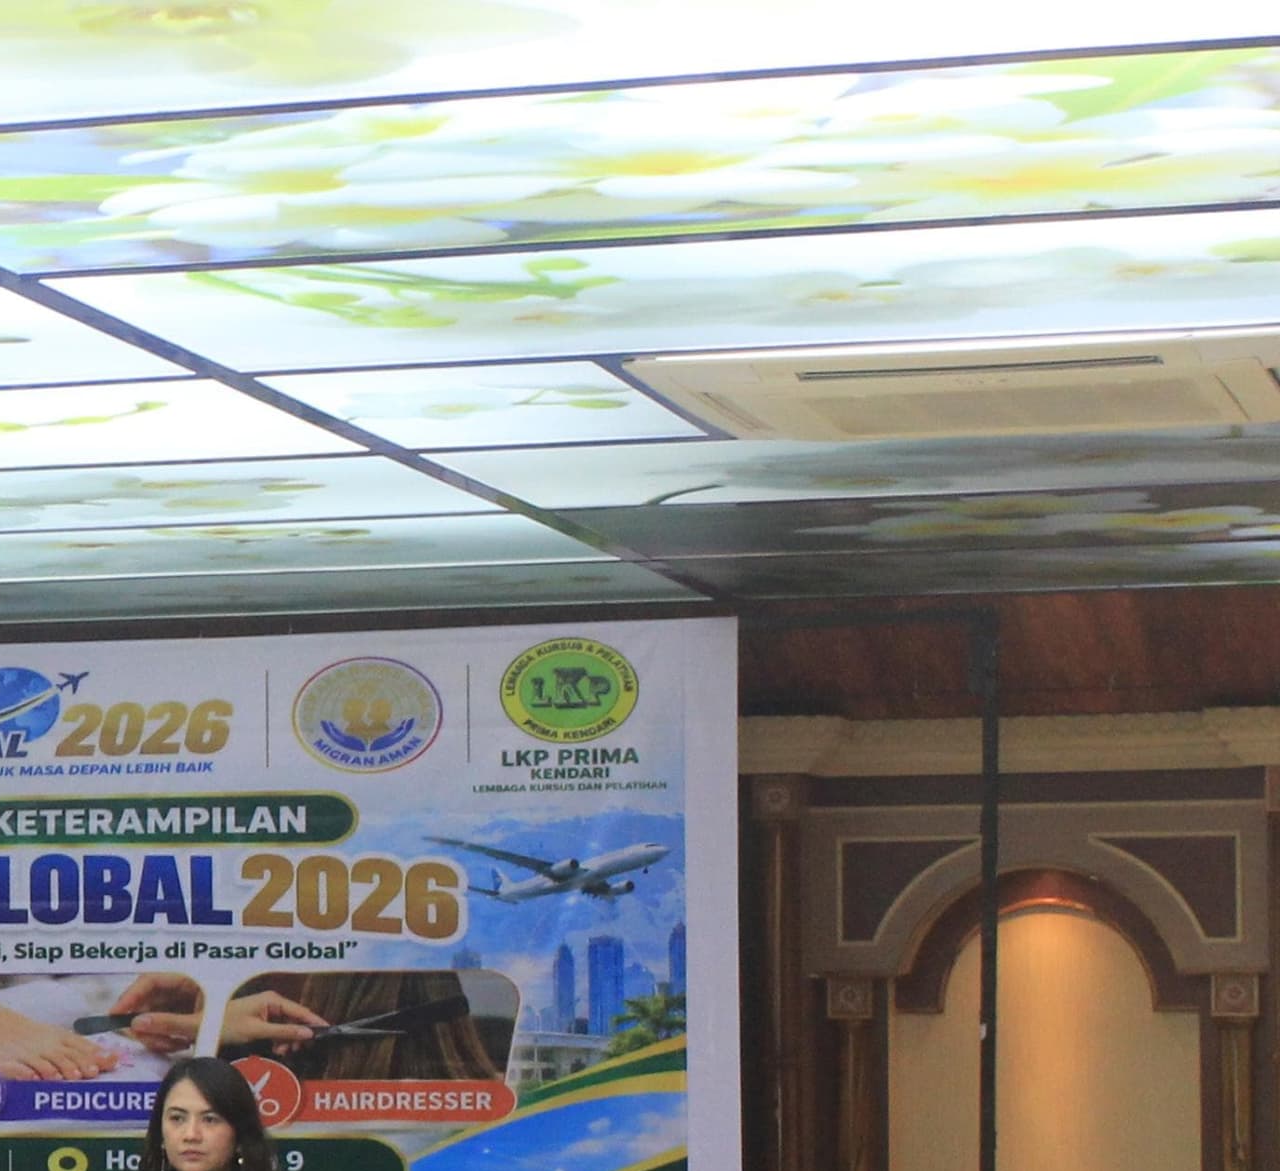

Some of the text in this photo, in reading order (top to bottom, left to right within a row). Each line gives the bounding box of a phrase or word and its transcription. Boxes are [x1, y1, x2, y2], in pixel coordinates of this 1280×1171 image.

[535, 641, 583, 657] KURSUS
[530, 667, 611, 709] LKP
[55, 698, 235, 758] 2026
[523, 717, 617, 740] PRIMA KENDARI
[313, 736, 423, 766] MIGRAN AMAN
[502, 748, 639, 767] LKP PRIMA
[19, 764, 65, 776] MASA
[68, 763, 122, 775] DEPAN
[126, 762, 172, 774] LEBIH
[176, 761, 214, 773] BAIK
[531, 767, 610, 780] KENDARI
[473, 784, 526, 793] LEMBAGA
[529, 783, 574, 792] KURSUS
[578, 782, 603, 791] DAN
[241, 853, 459, 940] 2026
[13, 942, 63, 964] Siap
[70, 940, 159, 963] Bekerja
[164, 940, 187, 959] di
[193, 943, 257, 960] Pasar
[34, 1091, 157, 1111] PEDICURE
[314, 1091, 492, 1111] HAIRDRESSER
[286, 1150, 304, 1171] 9
